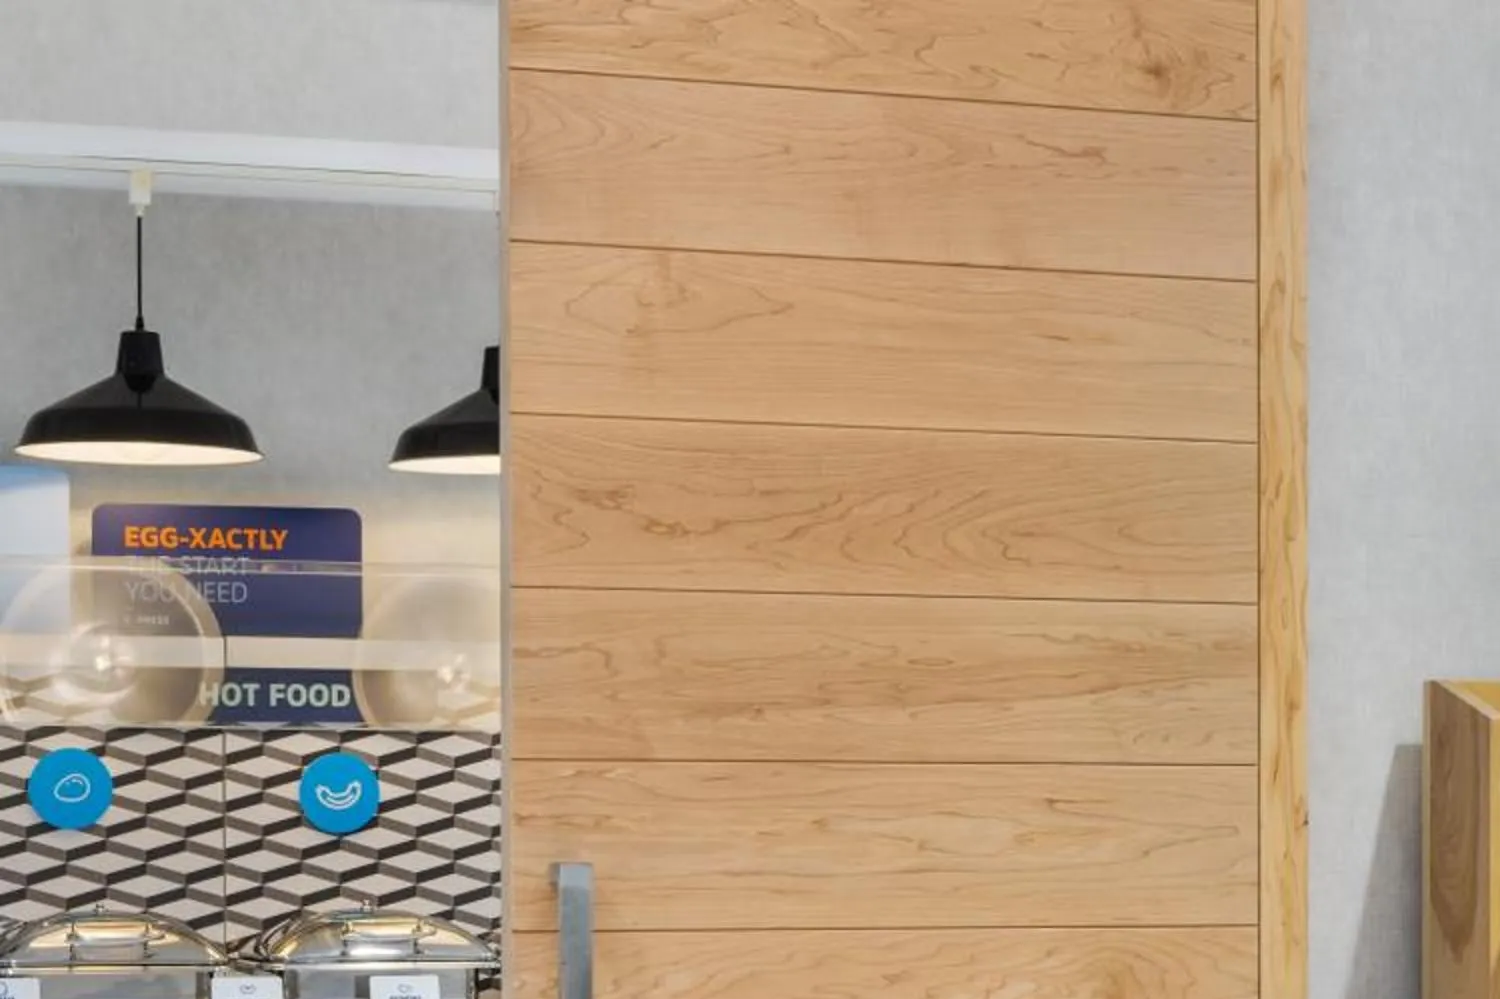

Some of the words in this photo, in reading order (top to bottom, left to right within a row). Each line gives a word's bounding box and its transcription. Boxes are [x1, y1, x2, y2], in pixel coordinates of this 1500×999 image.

[123, 525, 289, 550] EGG-XACTLY
[201, 683, 261, 706] HOT
[268, 683, 351, 708] FOOD
